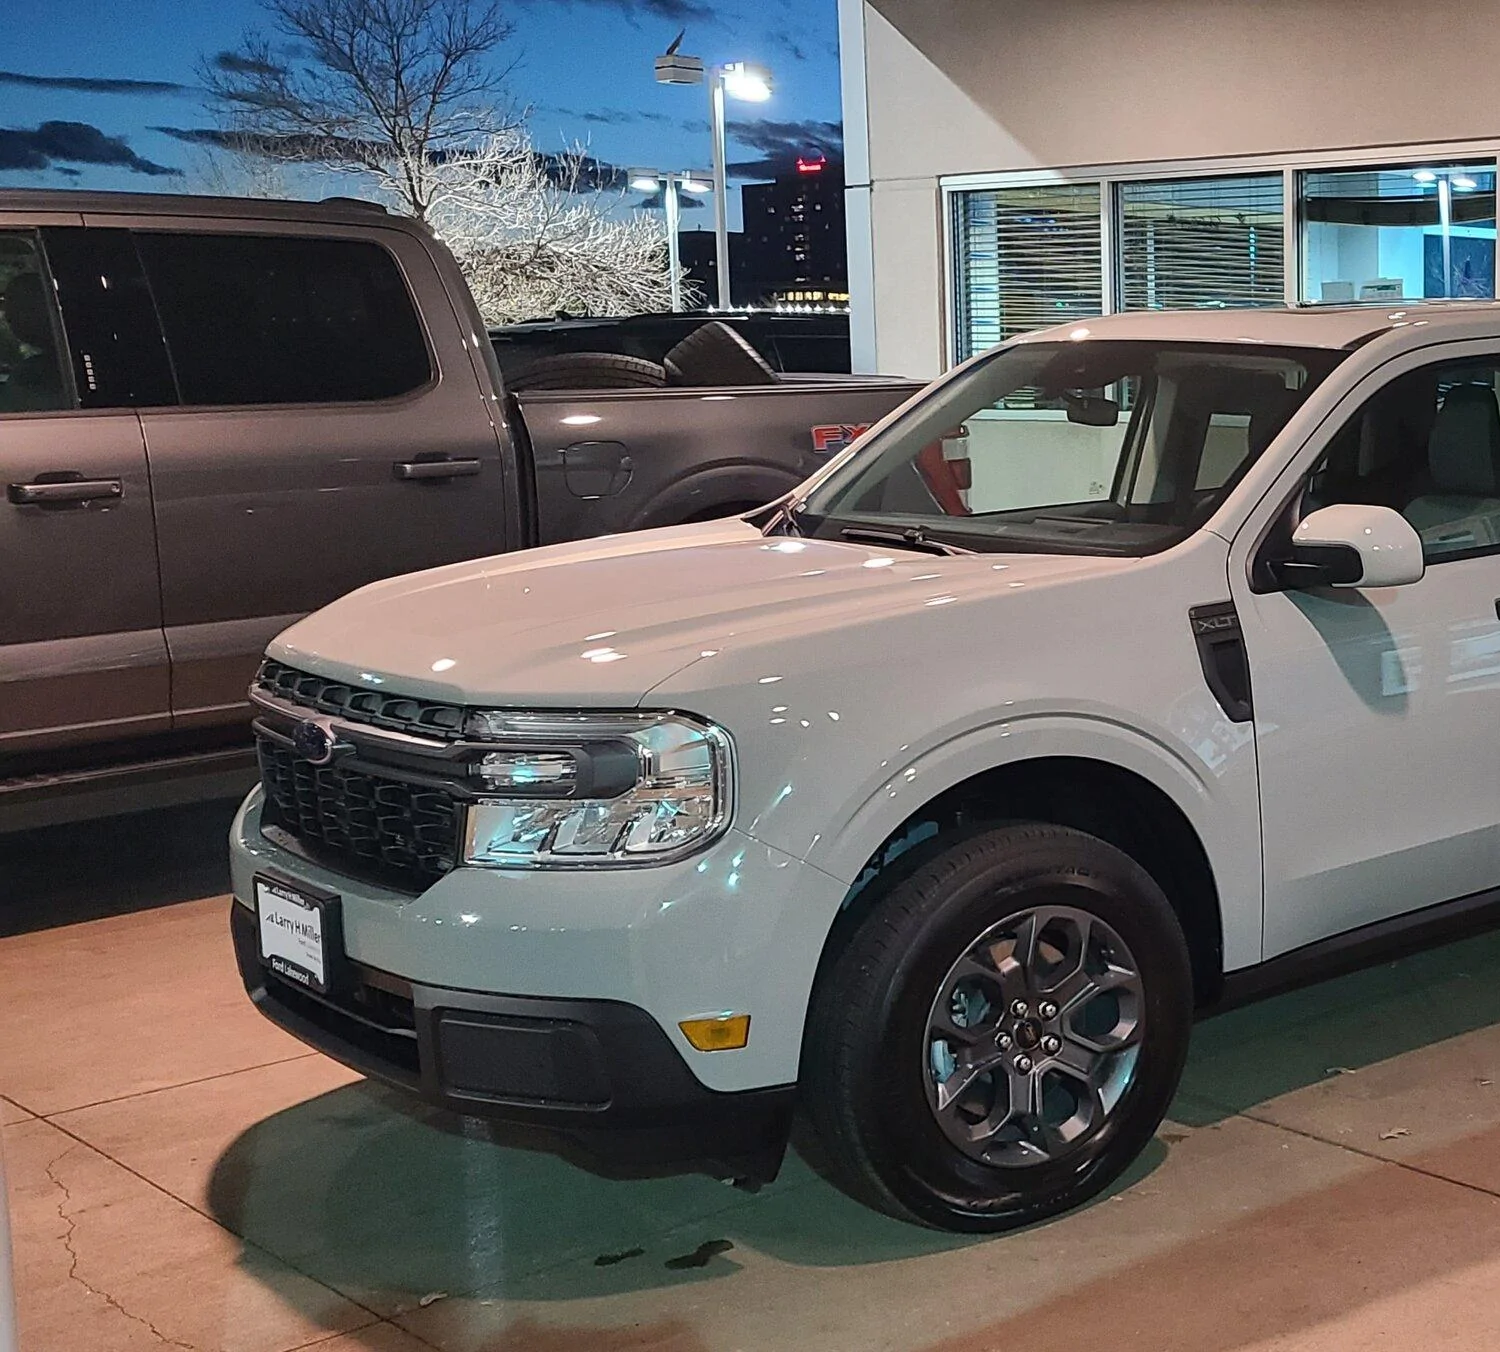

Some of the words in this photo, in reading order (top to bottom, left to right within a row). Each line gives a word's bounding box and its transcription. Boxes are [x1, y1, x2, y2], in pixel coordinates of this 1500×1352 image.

[1198, 616, 1237, 631] XLT
[275, 912, 294, 934] Larry
[302, 923, 320, 943] Miller
